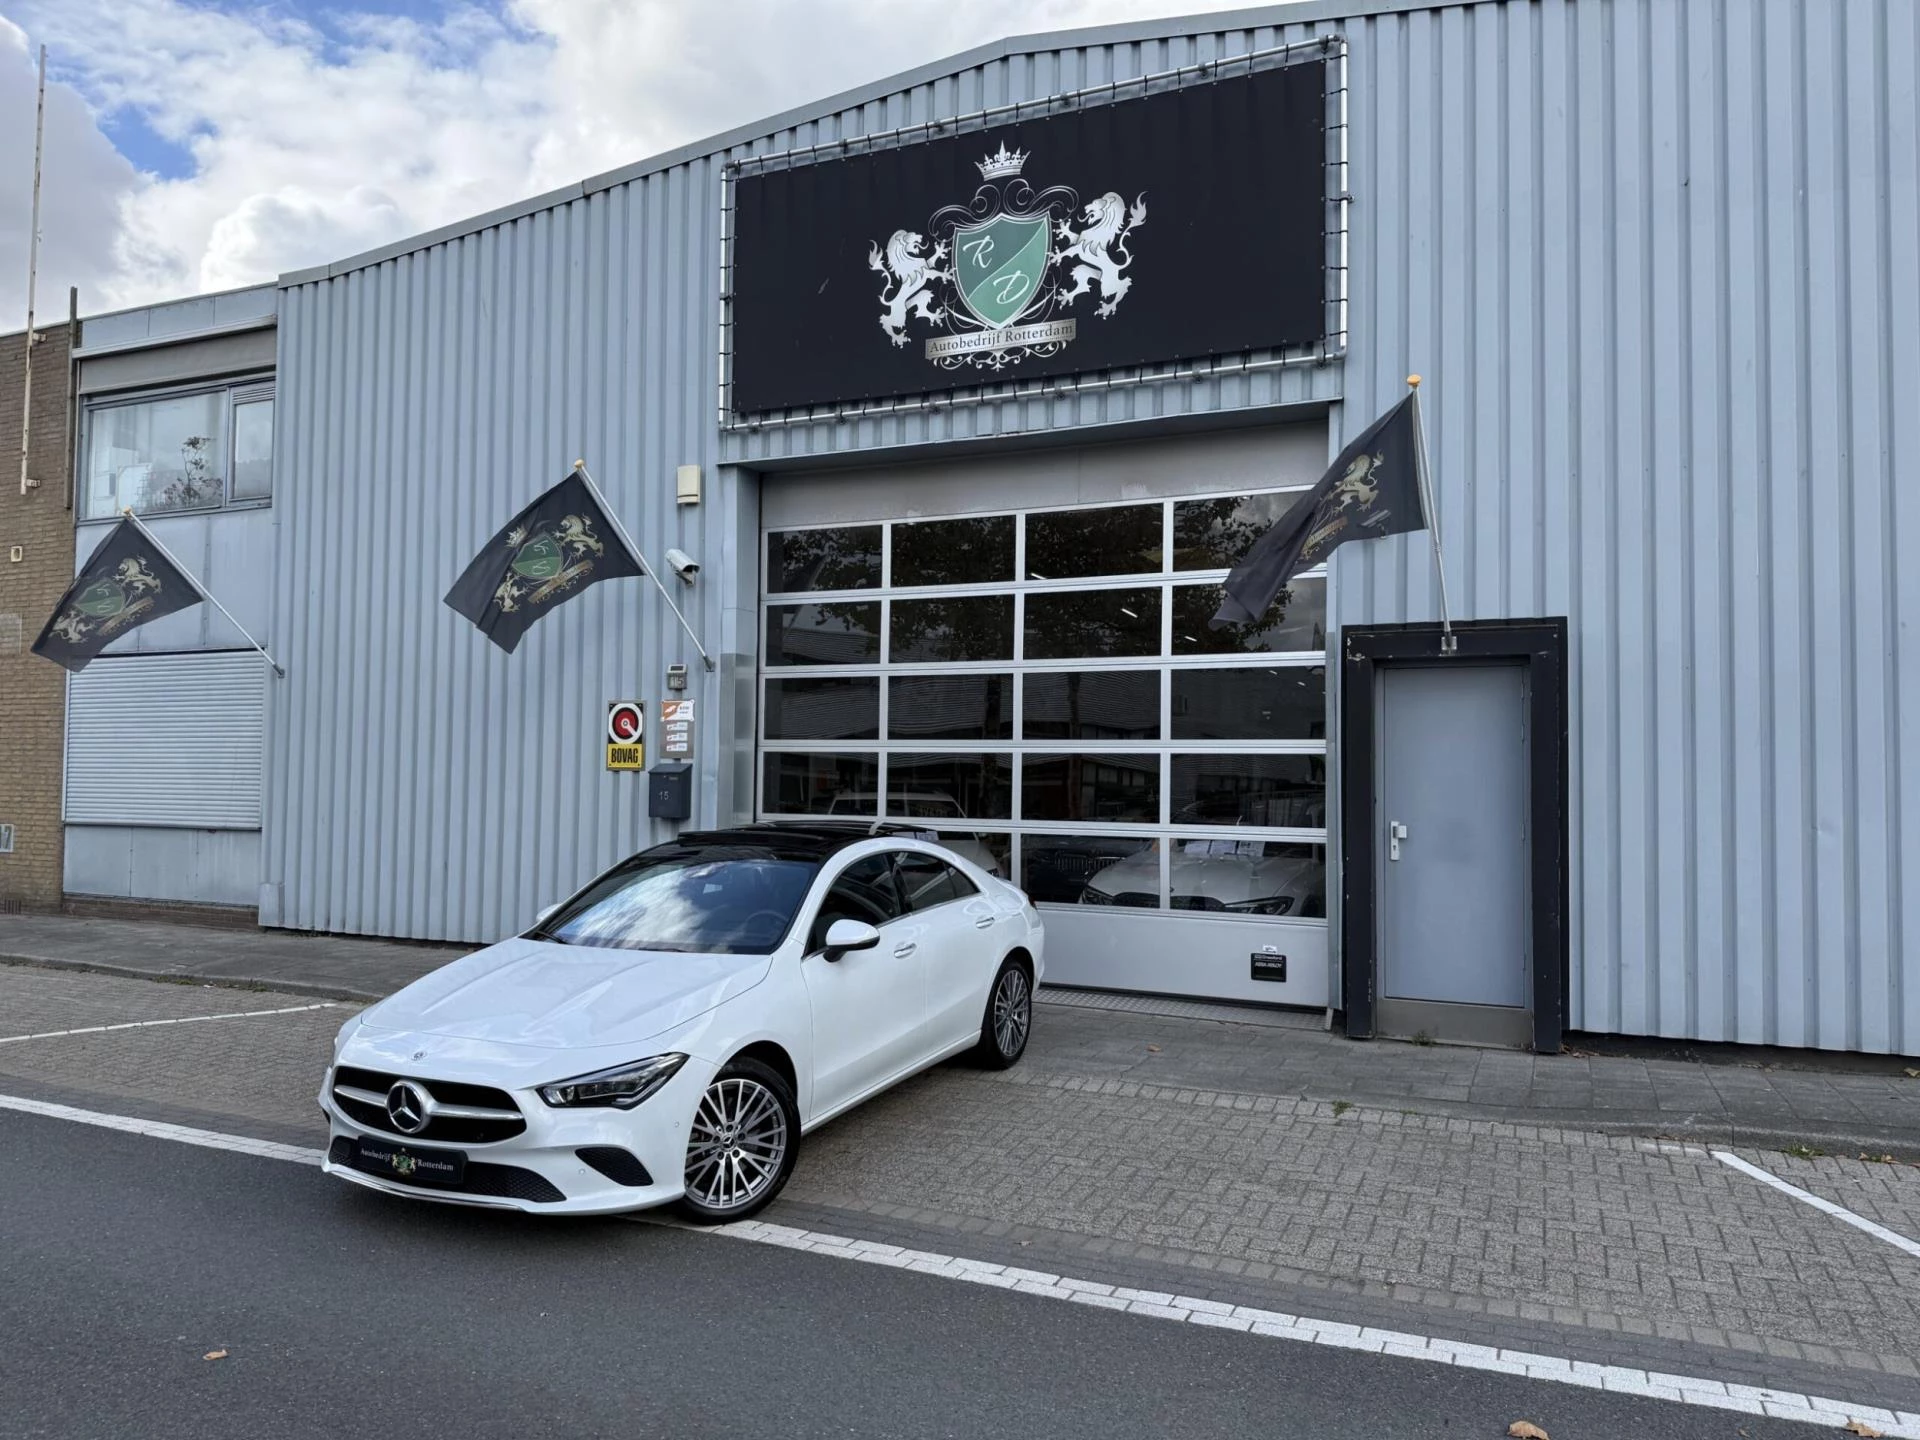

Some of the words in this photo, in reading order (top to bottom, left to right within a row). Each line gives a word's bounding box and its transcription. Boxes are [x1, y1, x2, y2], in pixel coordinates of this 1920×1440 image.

[962, 235, 995, 268] R
[930, 330, 1001, 353] Autobedrijf
[1005, 324, 1073, 342] Rotterdam
[611, 748, 639, 764] BOVAG
[658, 791, 669, 801] 15
[417, 1159, 454, 1171] Rotterdam
